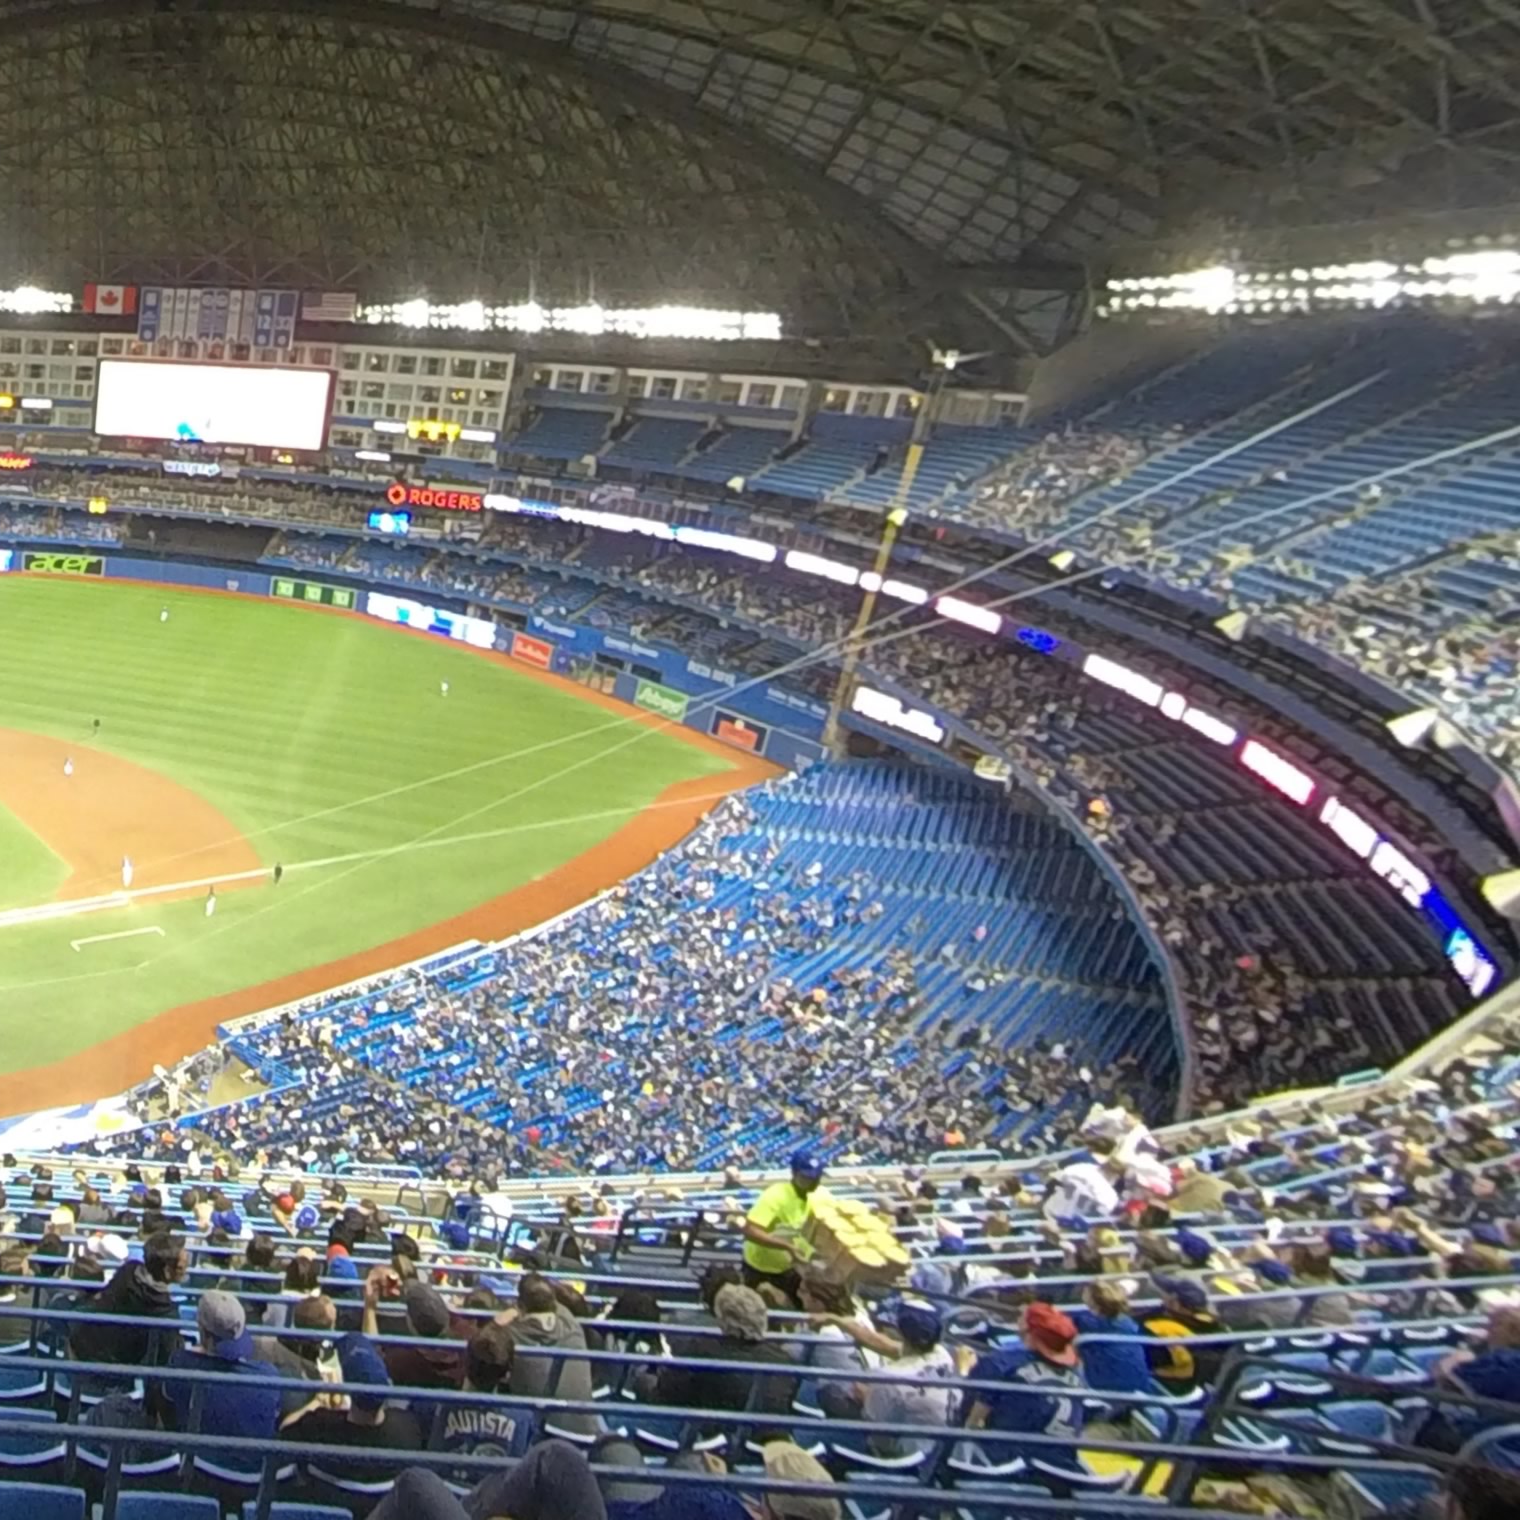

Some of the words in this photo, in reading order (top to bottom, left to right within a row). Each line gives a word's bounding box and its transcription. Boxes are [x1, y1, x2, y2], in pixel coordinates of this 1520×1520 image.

[408, 489, 481, 512] ROGERS
[30, 553, 97, 574] acer
[444, 1409, 516, 1442] AUTISTA
